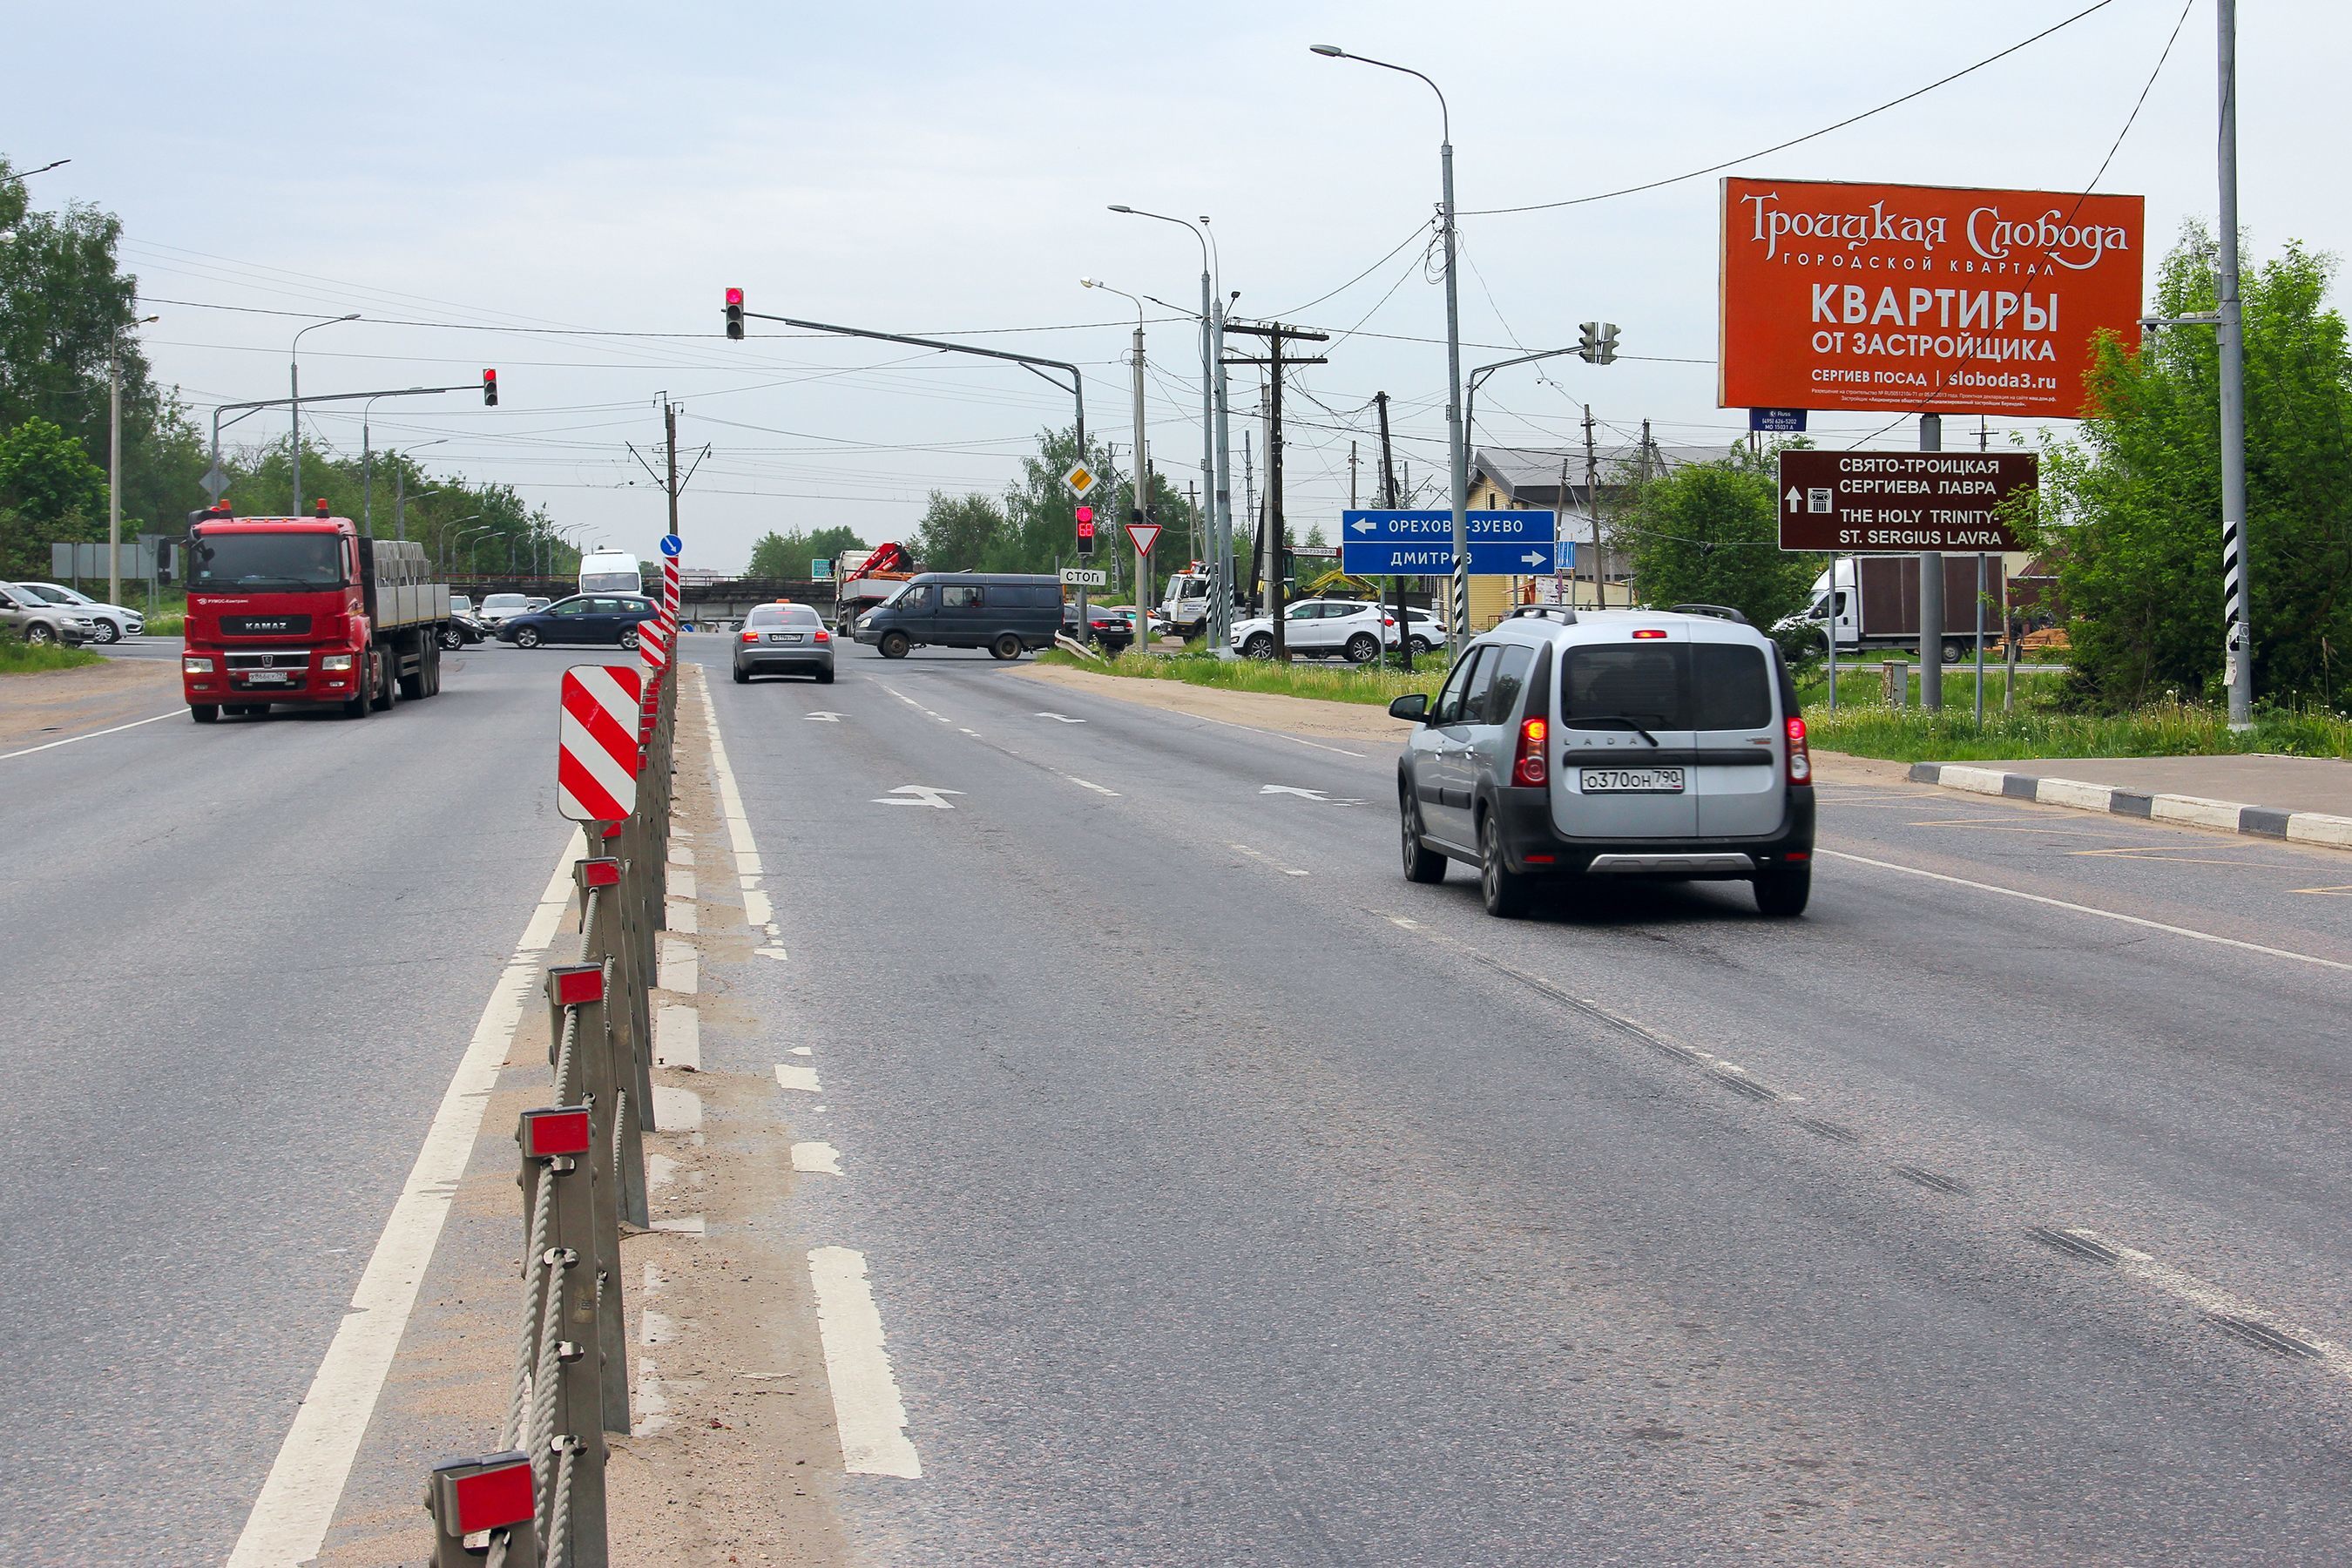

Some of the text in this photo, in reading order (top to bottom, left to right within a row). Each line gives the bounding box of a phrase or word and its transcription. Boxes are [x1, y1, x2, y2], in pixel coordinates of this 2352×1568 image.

[1740, 191, 2129, 270] Троицкая Слобода
[1784, 253, 2054, 276] ГОРОДСКОЙ КВАРТАЛ
[1811, 283, 2058, 332] КВАРТИРЫ
[1811, 331, 2056, 362] ОТ ЗАСТРОЙЩИКА
[1811, 368, 2057, 389] СЕРГИЕВ ПОСАД sloboda3.ru
[1839, 458, 1999, 475] СВЯТО-ТРОИЦКАЯ
[1839, 479, 1997, 495] СЕРГИЕВА ЛАВРА
[1840, 509, 2000, 524] THE HOLY TRINITY-
[1079, 523, 1092, 537] 68
[1389, 519, 1524, 534] ОРЕХОВ-ЗУЕВО
[1839, 530, 2002, 545] ST. SERGIUS LAVRA
[1390, 551, 1473, 566] ДМИТРВ
[1065, 571, 1099, 583] СТОП
[1586, 771, 1679, 787] О370ОН 790
